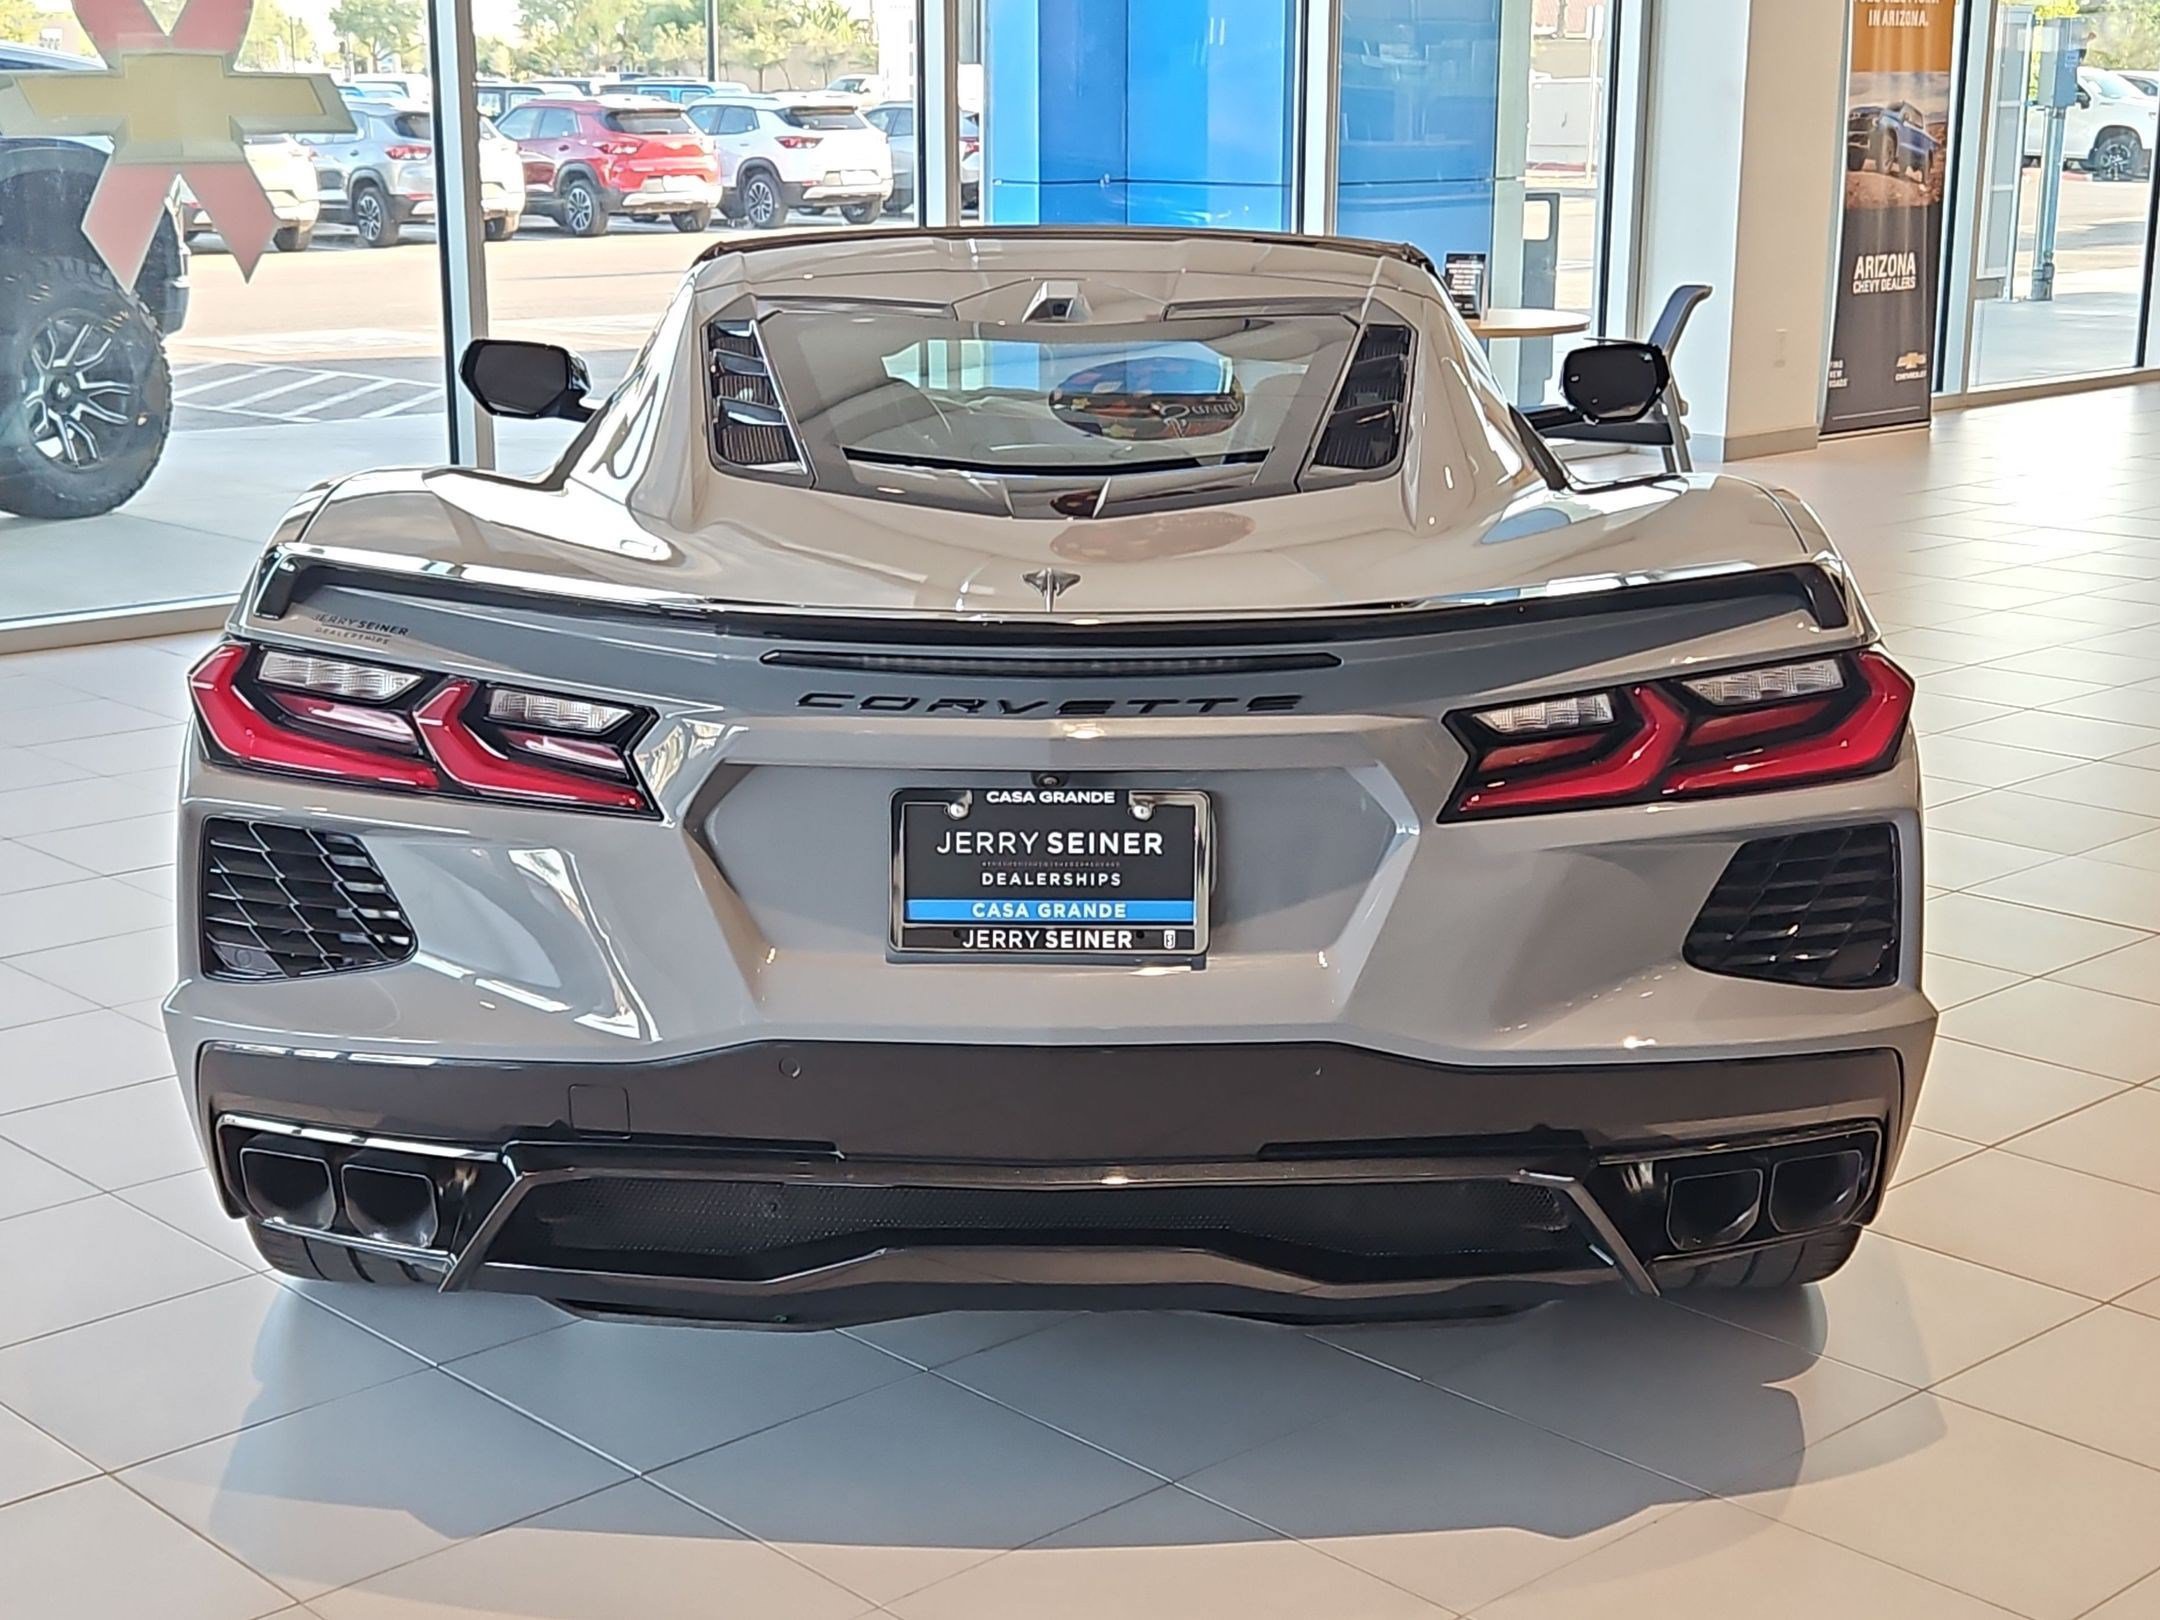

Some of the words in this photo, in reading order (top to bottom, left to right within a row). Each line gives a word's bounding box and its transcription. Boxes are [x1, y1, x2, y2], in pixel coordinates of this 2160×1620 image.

[1868, 9, 1880, 26] IN
[1881, 9, 1929, 27] ARIZONA.
[1853, 252, 1916, 280] ARIZONA
[1853, 280, 1880, 294] CHEVY
[1881, 276, 1916, 292] DEALERS
[312, 614, 356, 625] JERRY
[357, 620, 409, 636] SEINER
[797, 693, 1303, 714] CORVETTE
[986, 791, 1035, 804] CASA
[1039, 791, 1116, 804] GRANDE
[937, 832, 1039, 855] JERRY
[1047, 832, 1163, 855] SEINER
[981, 873, 1122, 887] DEALERSHIPS
[972, 903, 1029, 918] CASA
[1038, 903, 1127, 918] GRANDE
[962, 930, 1040, 949] JERRY
[1045, 931, 1132, 949] SEINER
